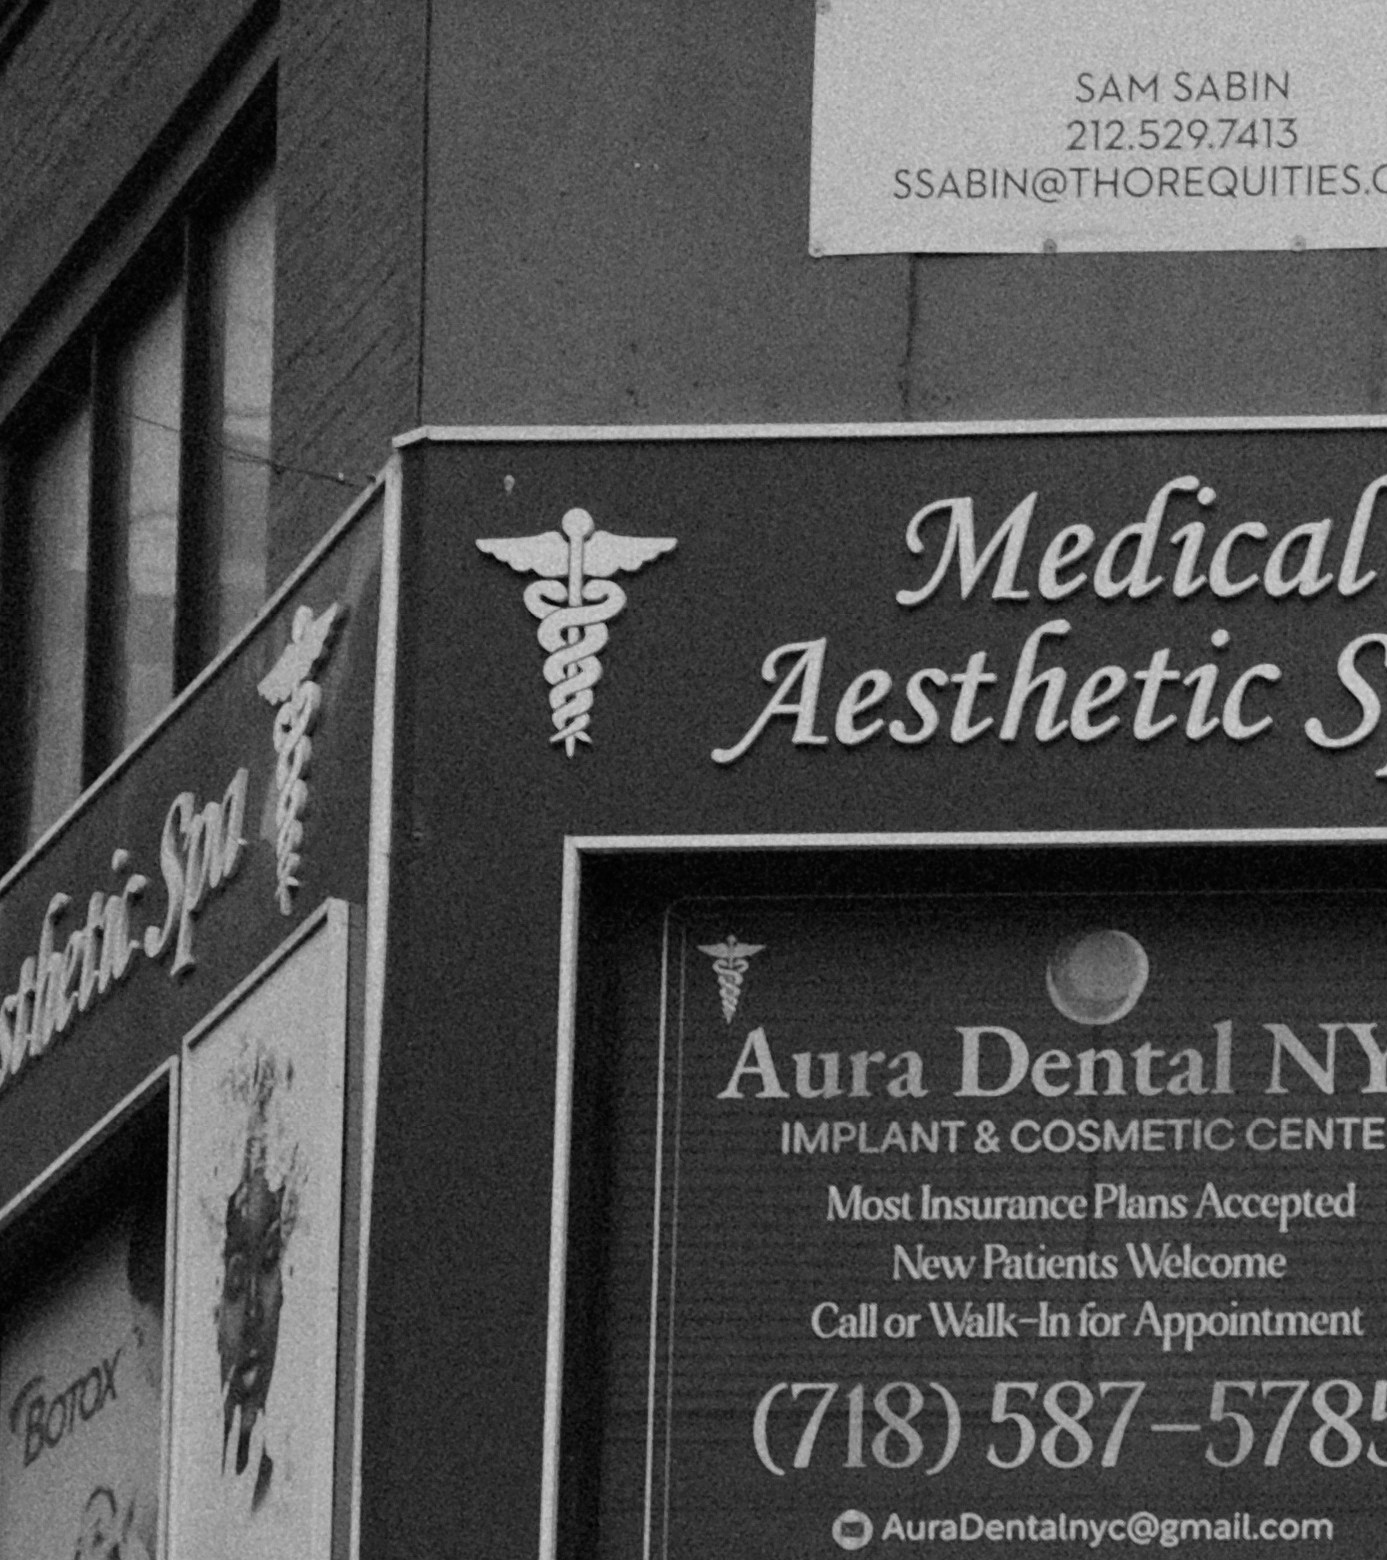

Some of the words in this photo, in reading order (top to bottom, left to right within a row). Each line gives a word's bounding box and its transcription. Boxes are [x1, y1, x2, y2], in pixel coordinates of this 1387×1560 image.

[1076, 72, 1158, 103] SAM
[1174, 71, 1289, 102] SABIN
[1067, 118, 1298, 151] 212.529.7413
[712, 619, 1280, 762] Aesthetic
[143, 766, 250, 976] Spa
[718, 1028, 927, 1098] Aura
[955, 1018, 1231, 1096] Dental
[782, 1121, 965, 1153] IMPLANT
[975, 1120, 999, 1153] &
[1011, 1119, 1233, 1152] COSMETIC
[828, 1185, 911, 1220] Most
[922, 1185, 1087, 1220] Insurance
[1095, 1184, 1187, 1218] Plans
[1195, 1182, 1355, 1232] Accepted
[894, 1245, 975, 1280] New
[984, 1244, 1117, 1279] Patients
[1127, 1243, 1286, 1278] Welcome
[812, 1302, 877, 1338] Call
[884, 1314, 920, 1337] or
[929, 1302, 1070, 1337] Walk-In
[1080, 1302, 1125, 1336] for
[1134, 1301, 1363, 1351] Appointment
[754, 1382, 960, 1475] (718)
[882, 1511, 1333, 1547] AuraDentalnyc@gmail.com
